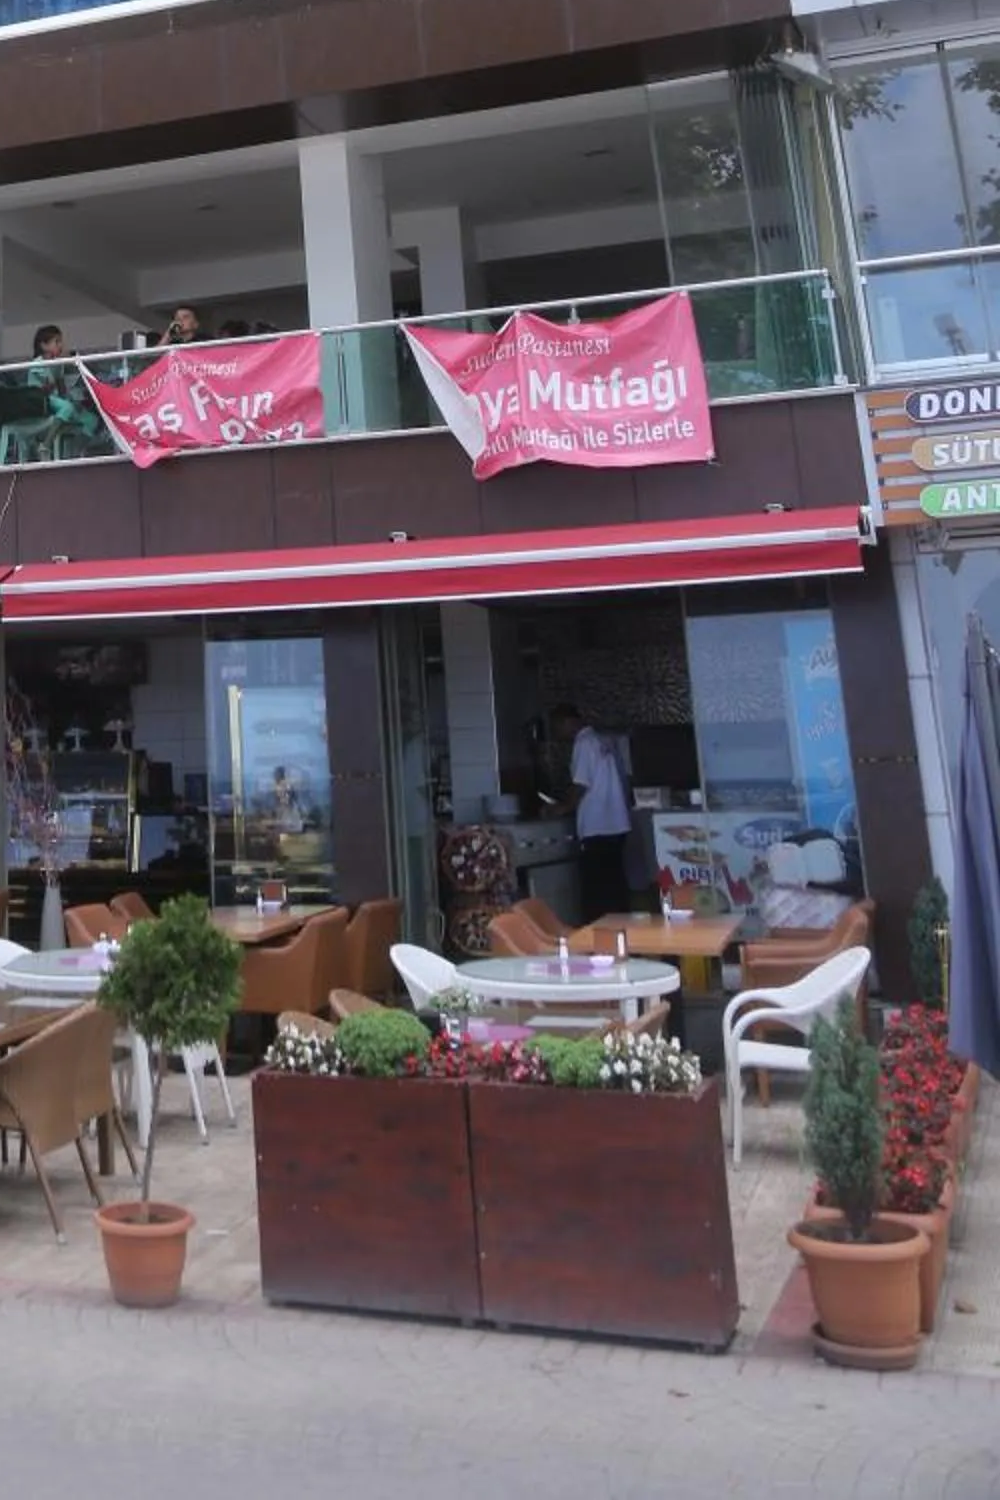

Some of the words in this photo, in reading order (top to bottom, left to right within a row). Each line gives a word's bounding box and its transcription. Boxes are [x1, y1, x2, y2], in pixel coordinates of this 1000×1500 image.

[480, 383, 519, 431] ya
[529, 360, 687, 412] Mutfağı
[919, 385, 1000, 419] DON
[583, 425, 608, 449] ile
[613, 417, 695, 446] Sizlerle
